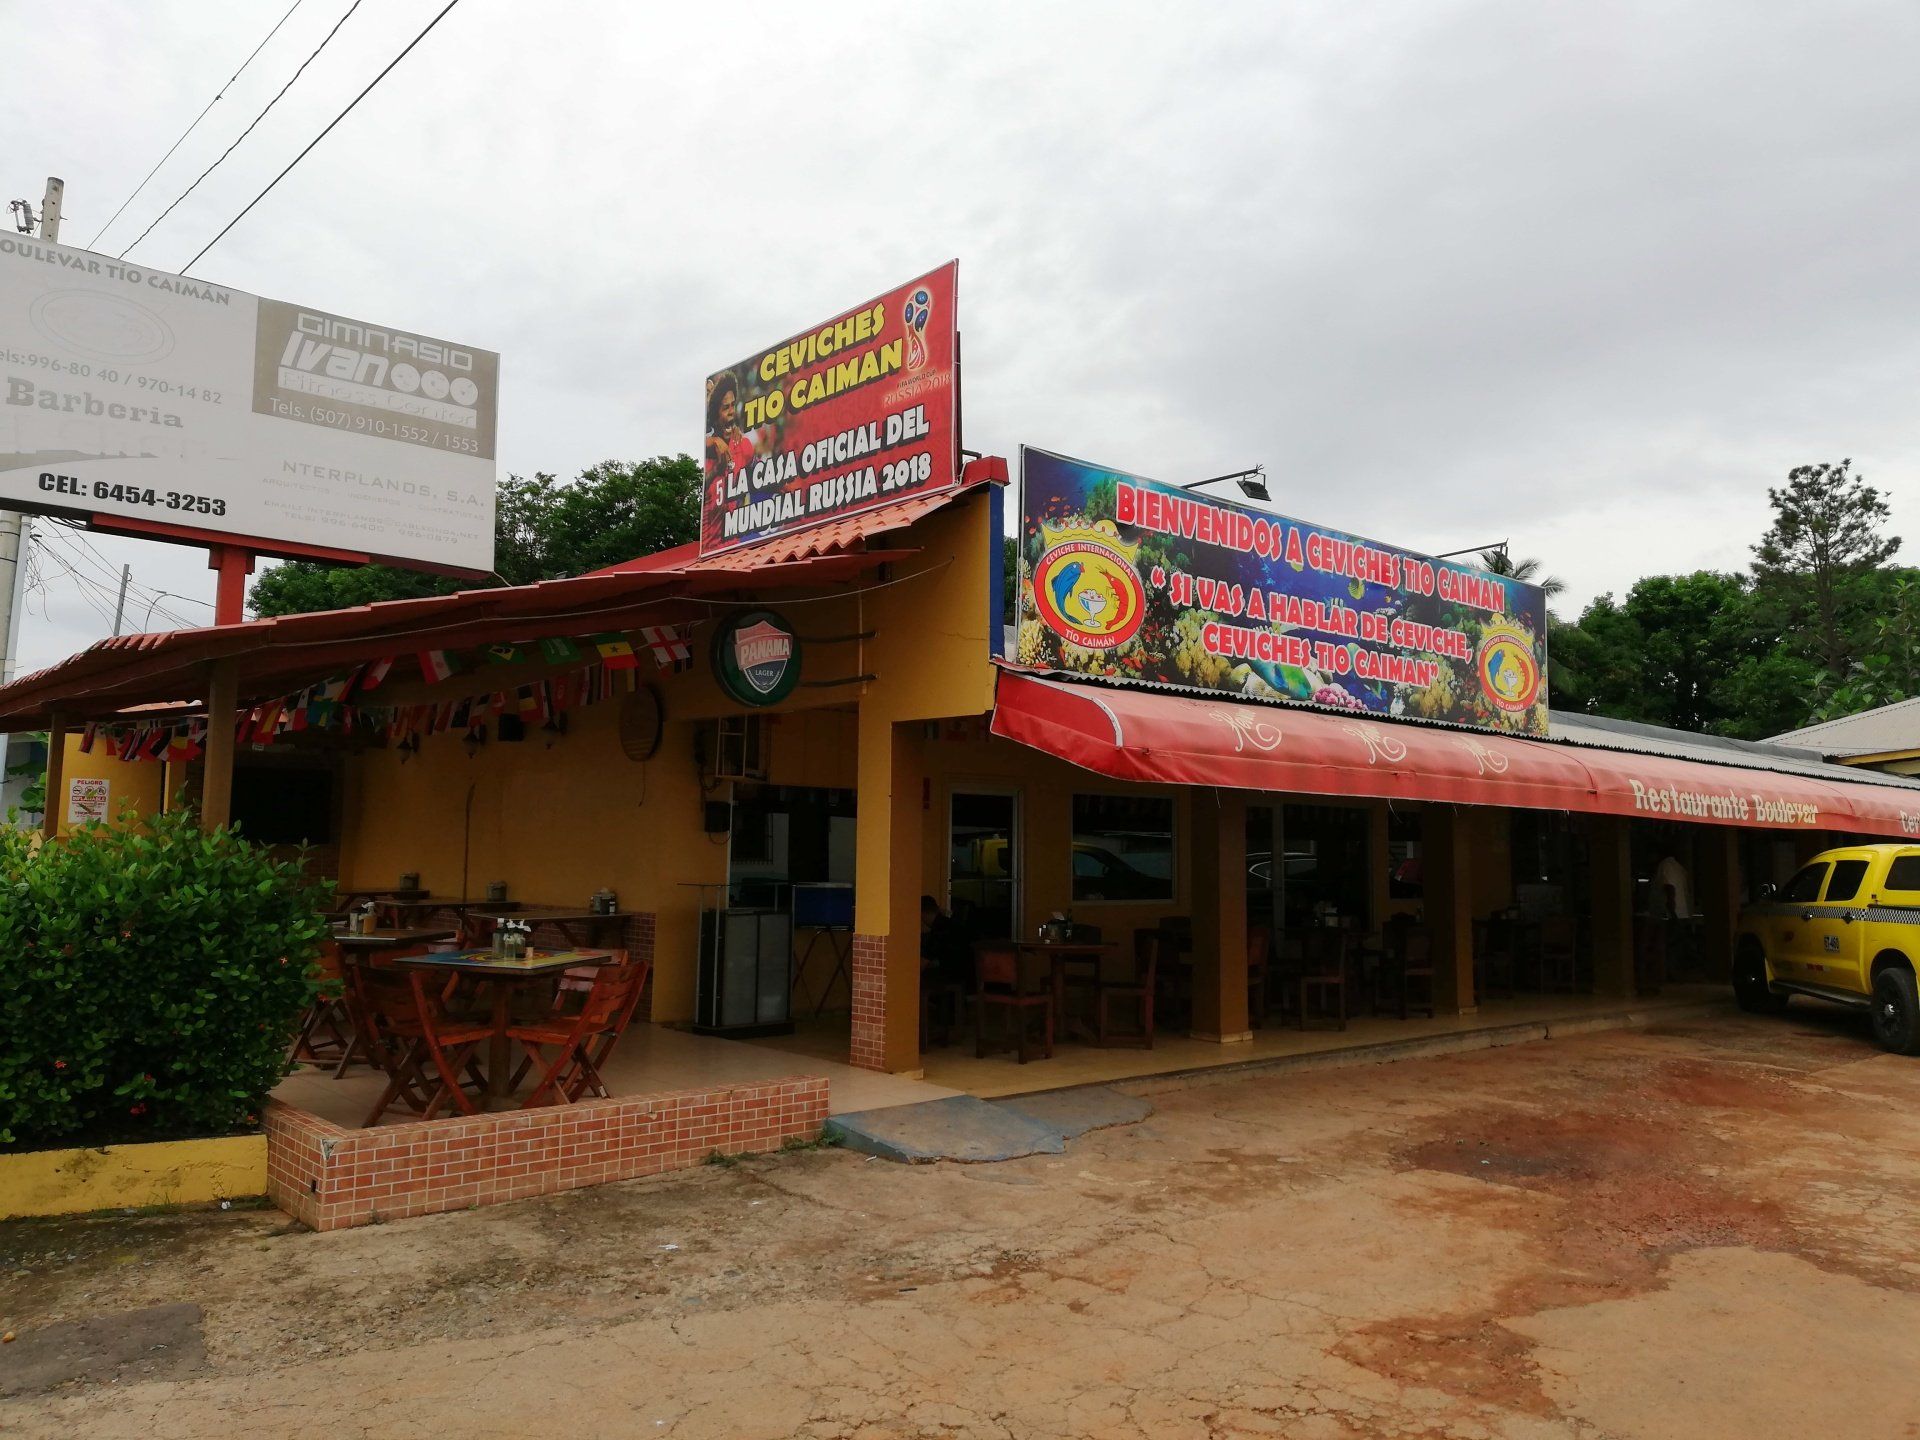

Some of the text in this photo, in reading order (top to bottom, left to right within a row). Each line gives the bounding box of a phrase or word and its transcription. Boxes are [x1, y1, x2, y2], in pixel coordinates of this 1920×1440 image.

[106, 262, 142, 284] TÍO
[147, 275, 230, 306] CAIMÁN
[280, 330, 389, 387] Ivan
[760, 302, 885, 382] CEVICHES
[97, 369, 119, 385] 40
[124, 372, 132, 385] /
[138, 376, 196, 398] 970-14
[202, 389, 223, 404] 82
[744, 337, 903, 428] TIO CAIMAN
[269, 397, 479, 452] Tels. (507) 910-1552 / 1553
[726, 404, 930, 499] LA CASA OFICIAL DEL
[38, 472, 226, 516] CEL: 6454-3253
[447, 489, 485, 506] S.A.
[724, 452, 931, 538] MUNDIAL RUSSIA 2018
[1046, 543, 1134, 581] CEVICHE INTERNACIONAL
[1116, 481, 1505, 614] BIENVENIDOS A CEVICHES TIO CAIMAN
[1065, 628, 1116, 648] TÍO CAIMÁN
[1196, 576, 1244, 616] VAS
[1247, 587, 1266, 622] A
[1269, 592, 1358, 639] HABLAR
[1360, 611, 1389, 644] DE
[1391, 619, 1473, 664] CEVICHE,
[740, 638, 790, 665] PANAMA
[755, 669, 774, 677] LAGER
[1201, 622, 1310, 669] CEVICHES
[1315, 641, 1350, 676] TIO
[1629, 779, 1749, 821] Restaurante
